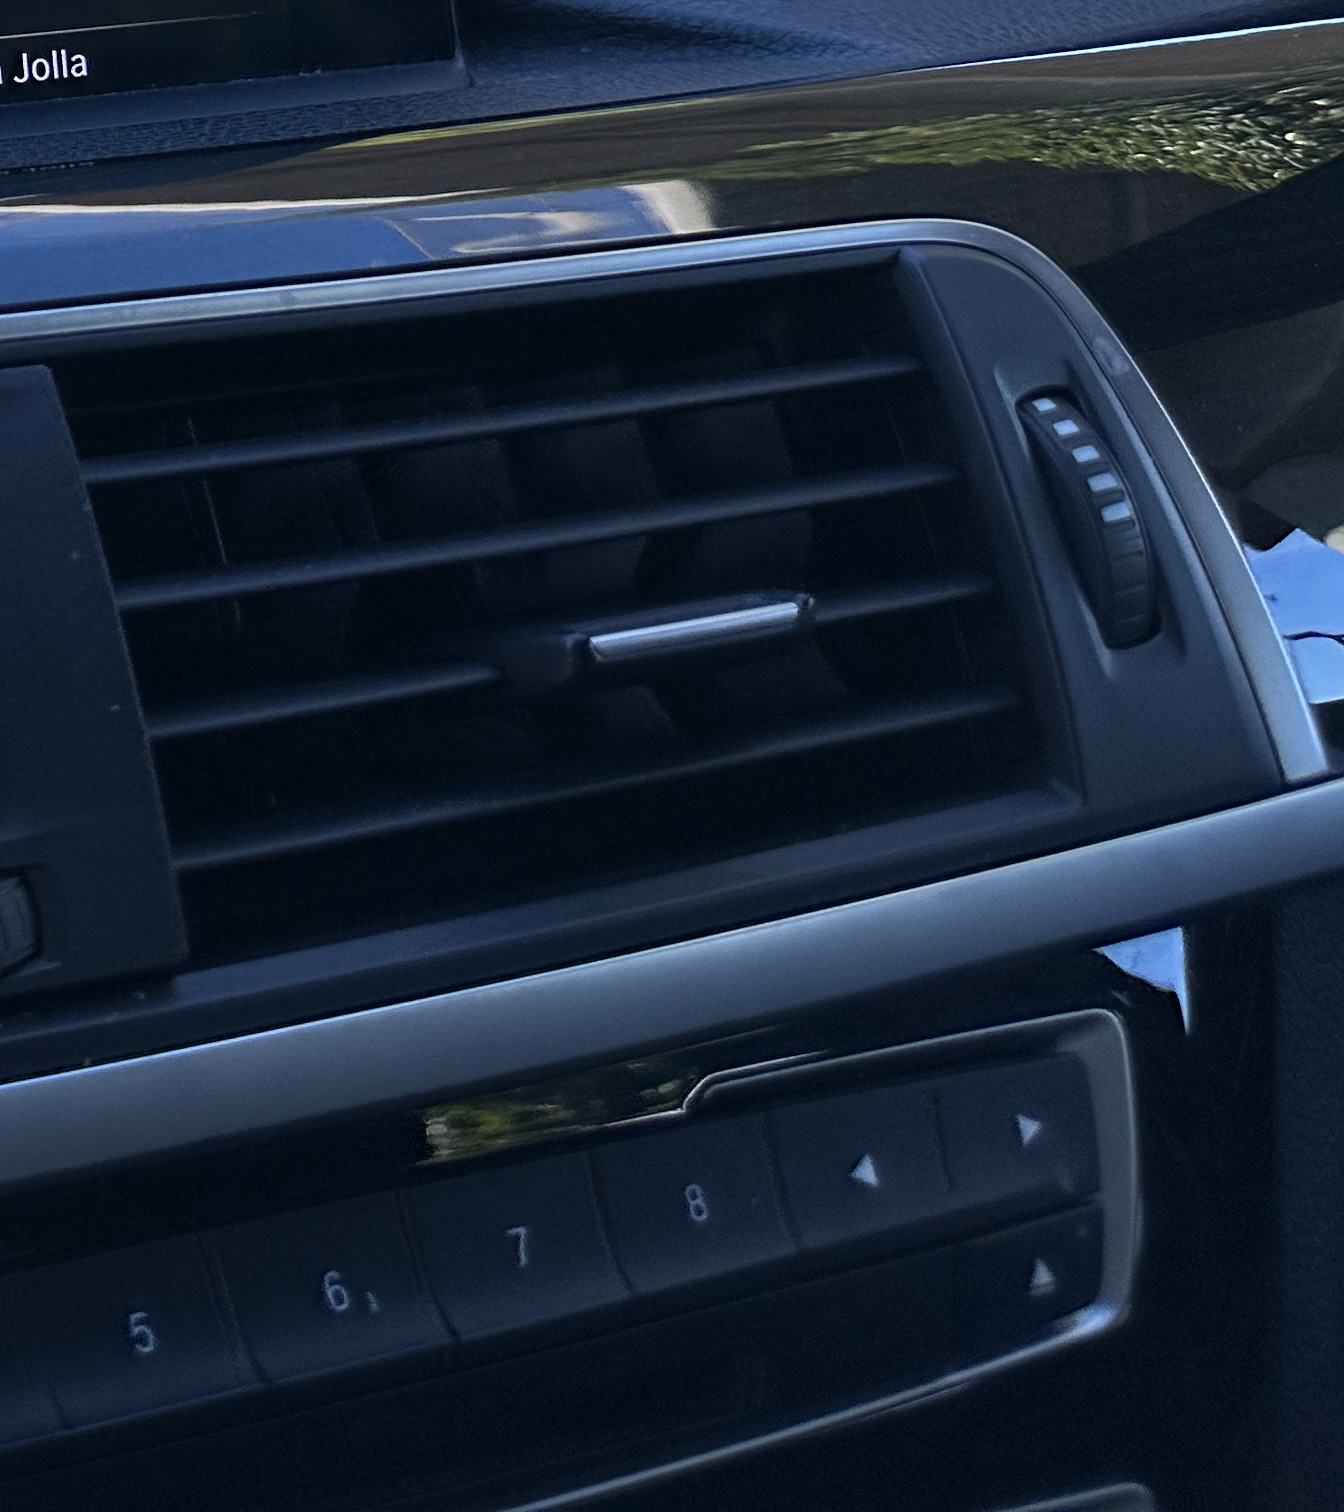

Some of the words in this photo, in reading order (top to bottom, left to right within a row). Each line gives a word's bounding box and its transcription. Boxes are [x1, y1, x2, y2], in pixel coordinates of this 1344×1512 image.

[13, 48, 88, 84] Jolla
[684, 1183, 709, 1223] 8
[507, 1226, 529, 1267] 7
[323, 1270, 351, 1312] 6
[129, 1311, 158, 1354] 5
